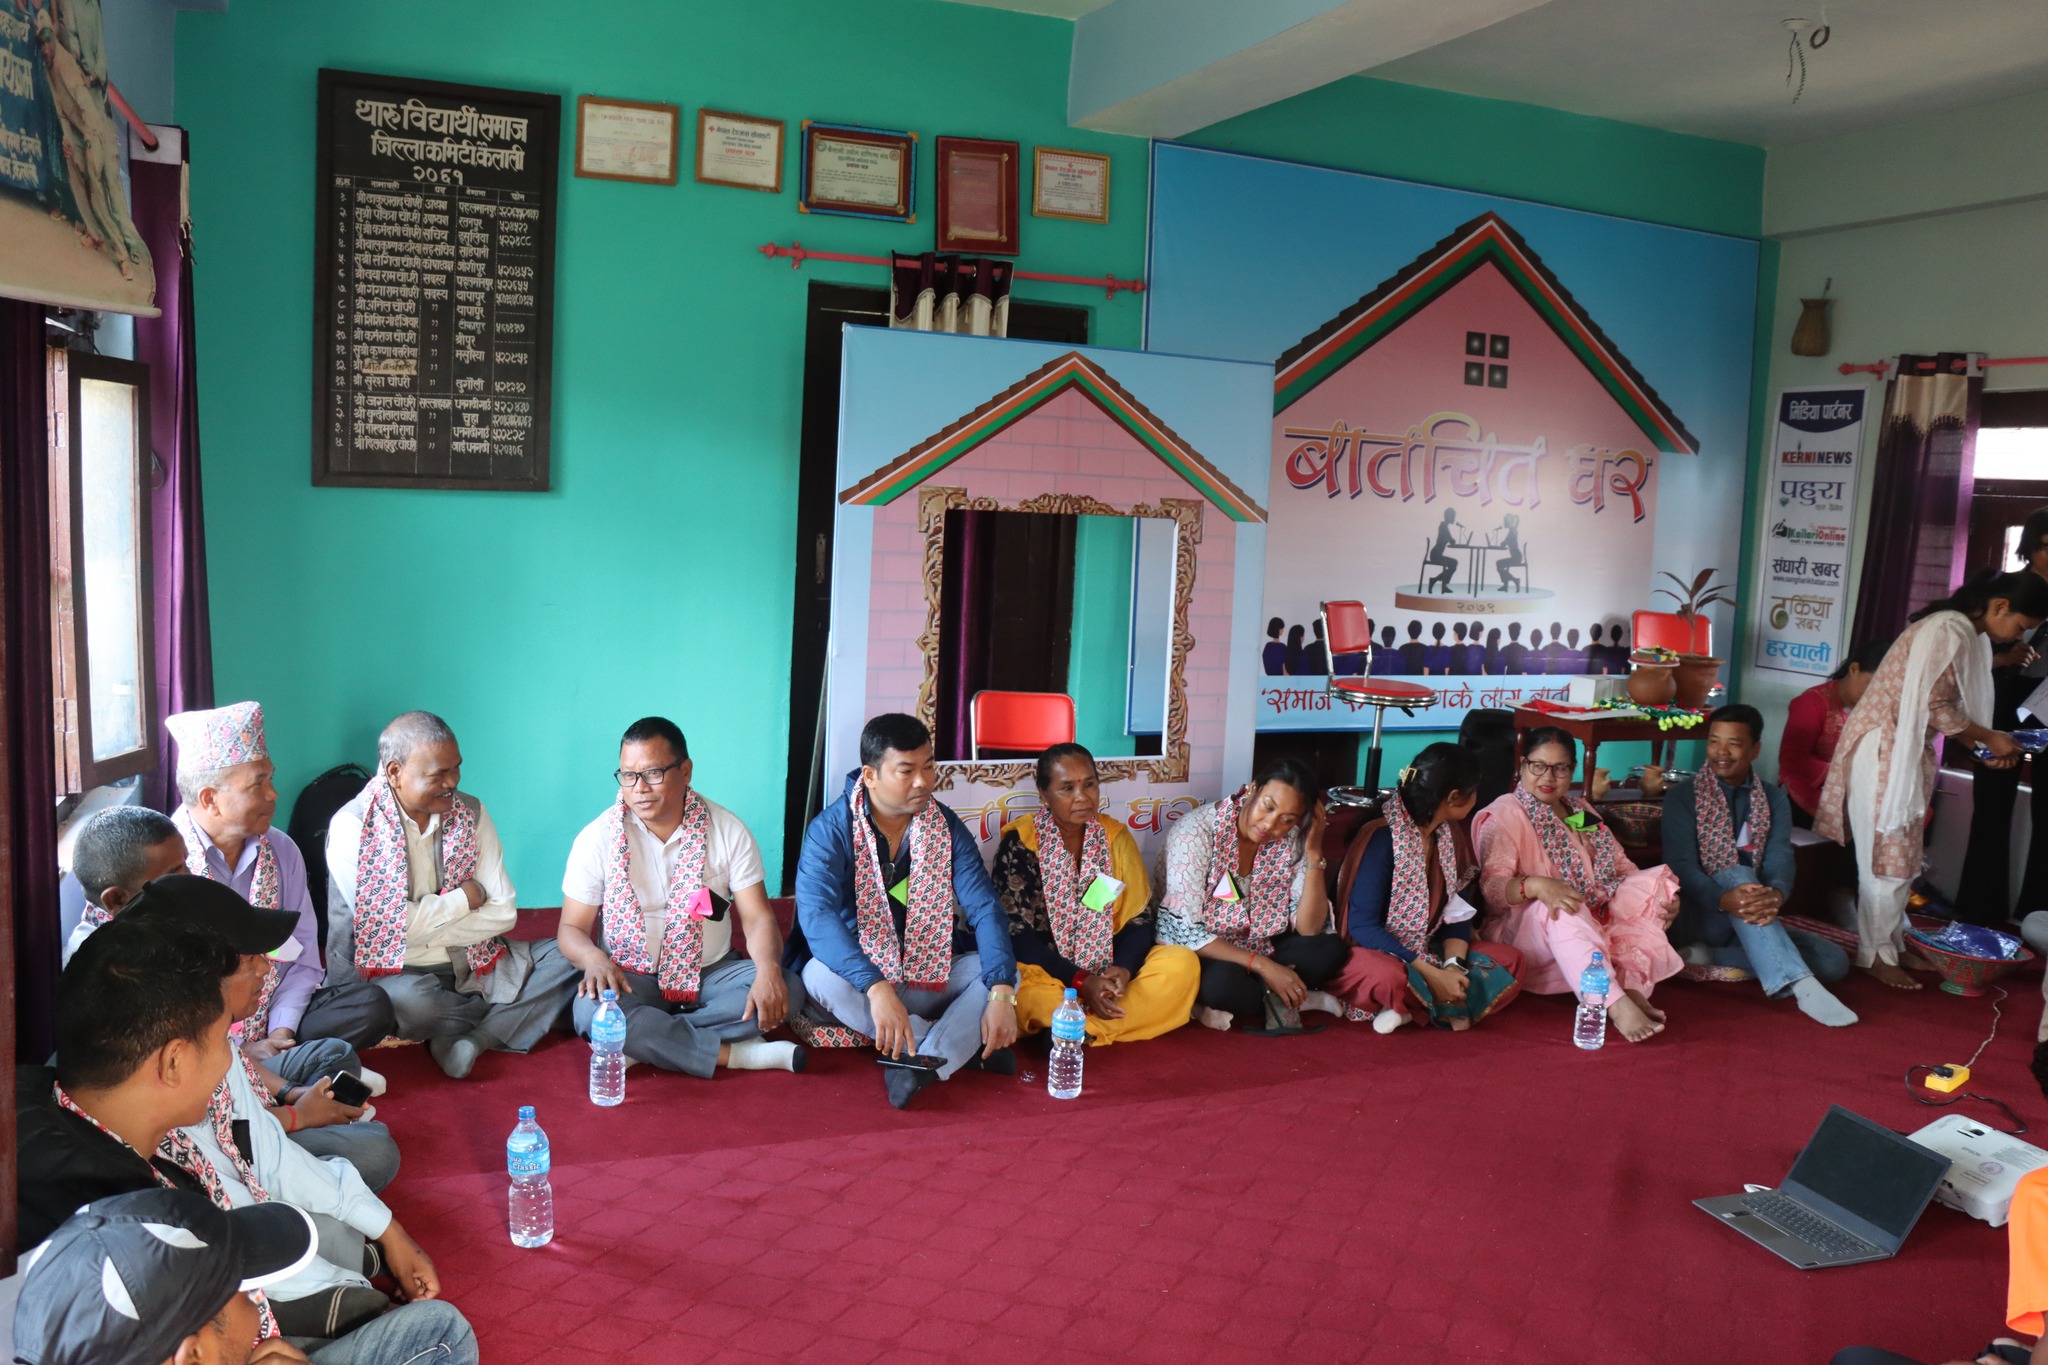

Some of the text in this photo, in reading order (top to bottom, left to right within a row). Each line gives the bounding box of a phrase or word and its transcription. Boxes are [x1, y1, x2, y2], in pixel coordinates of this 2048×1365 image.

[400, 98, 479, 137] विद्यार्थी
[479, 114, 528, 143] समाज
[371, 129, 425, 162] जिल्ला
[476, 141, 525, 172] कैलाली
[413, 165, 464, 185] २०६१
[459, 216, 484, 231] रतनपुर
[422, 226, 449, 241] सचिव
[381, 270, 396, 283] राम
[366, 297, 391, 312] अनिल
[353, 327, 364, 341] श्री
[393, 329, 417, 344] चौधरी
[455, 332, 476, 349] श्रीपुर
[387, 373, 411, 388] चौधरी
[353, 392, 366, 406] श्री
[353, 406, 366, 419] श्री
[1789, 400, 1854, 420] मिडिया पार्टनर
[353, 420, 365, 434] श्री
[1283, 411, 1653, 523] बातचित घर
[1781, 480, 1846, 506] पहुरा
[1772, 556, 1842, 578] संघारी खबर
[1795, 617, 1822, 632] खबर
[1766, 639, 1832, 662] हरचाली
